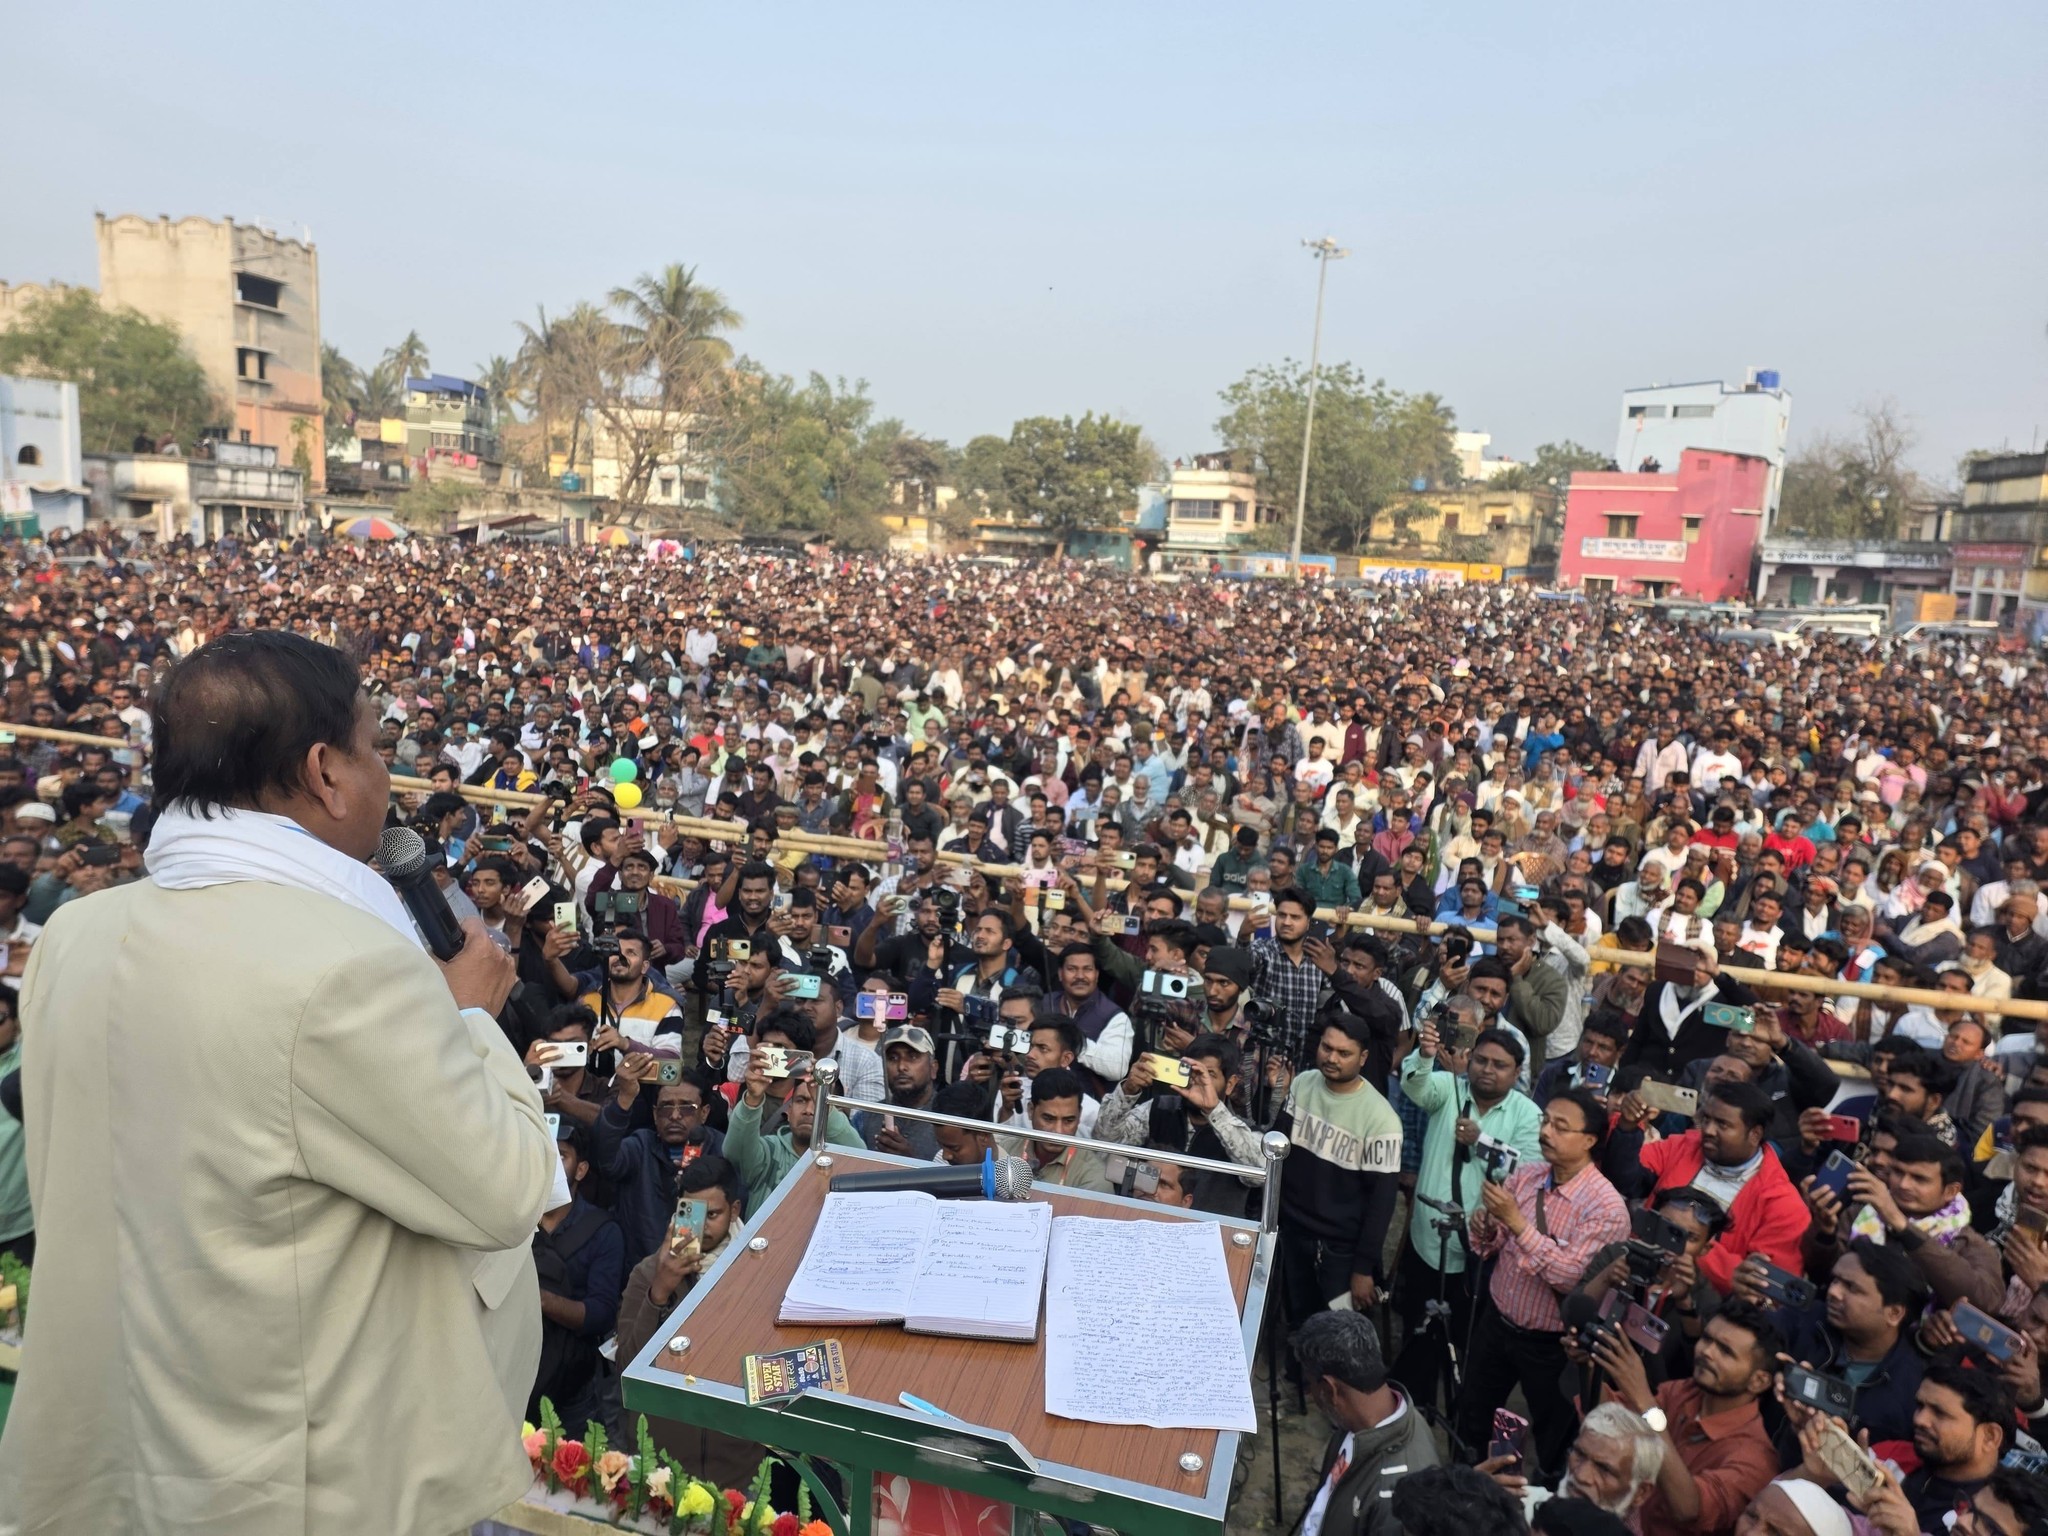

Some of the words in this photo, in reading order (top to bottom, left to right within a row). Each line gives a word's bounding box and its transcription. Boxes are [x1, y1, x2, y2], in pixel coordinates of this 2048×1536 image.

[1223, 872, 1247, 884] adid
[830, 1341, 839, 1356] STAR
[833, 1357, 843, 1374] SUPER
[763, 1362, 773, 1391] SUPER
[772, 1365, 782, 1387] STAR
[834, 1376, 846, 1389] JK
